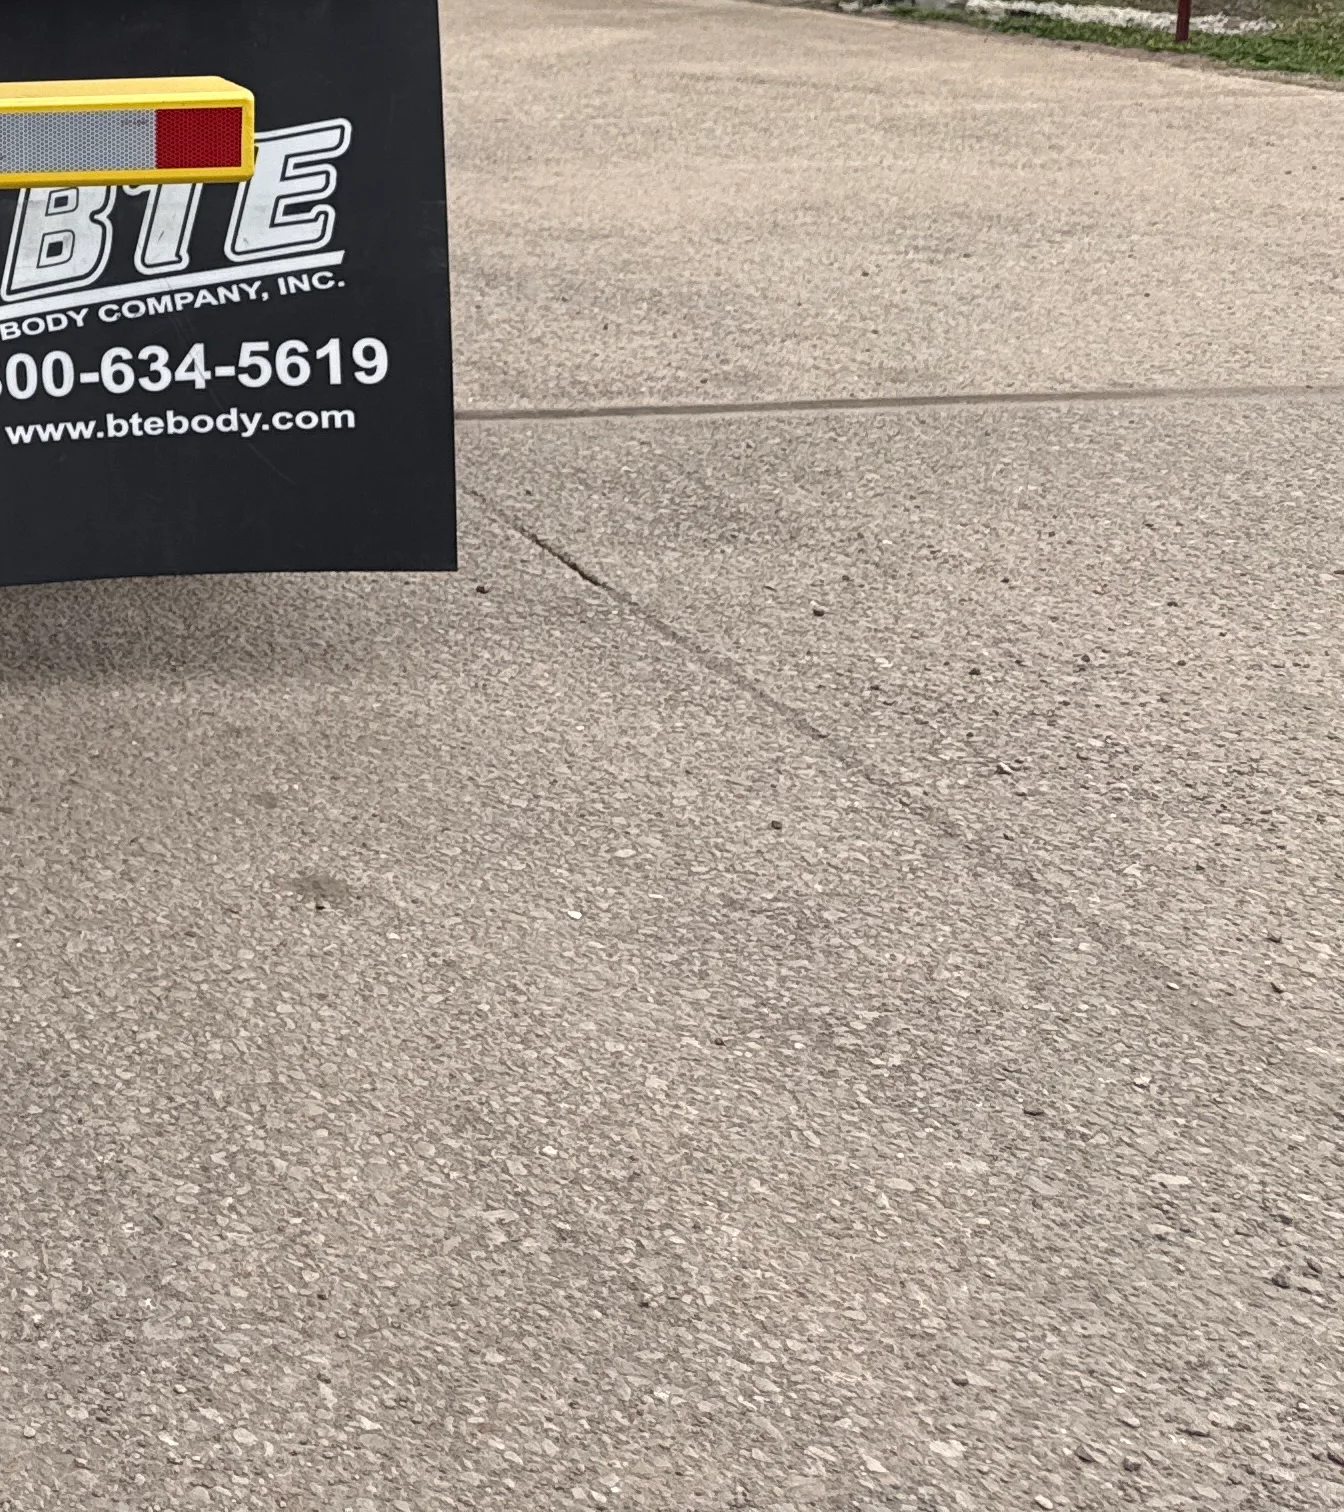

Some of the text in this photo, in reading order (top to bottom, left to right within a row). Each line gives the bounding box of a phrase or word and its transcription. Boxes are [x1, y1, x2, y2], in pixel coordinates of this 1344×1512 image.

[0, 117, 353, 303] BTE
[97, 280, 269, 323] COMPANY,
[277, 270, 345, 296] INC.
[4, 407, 356, 445] www.btebody.com
